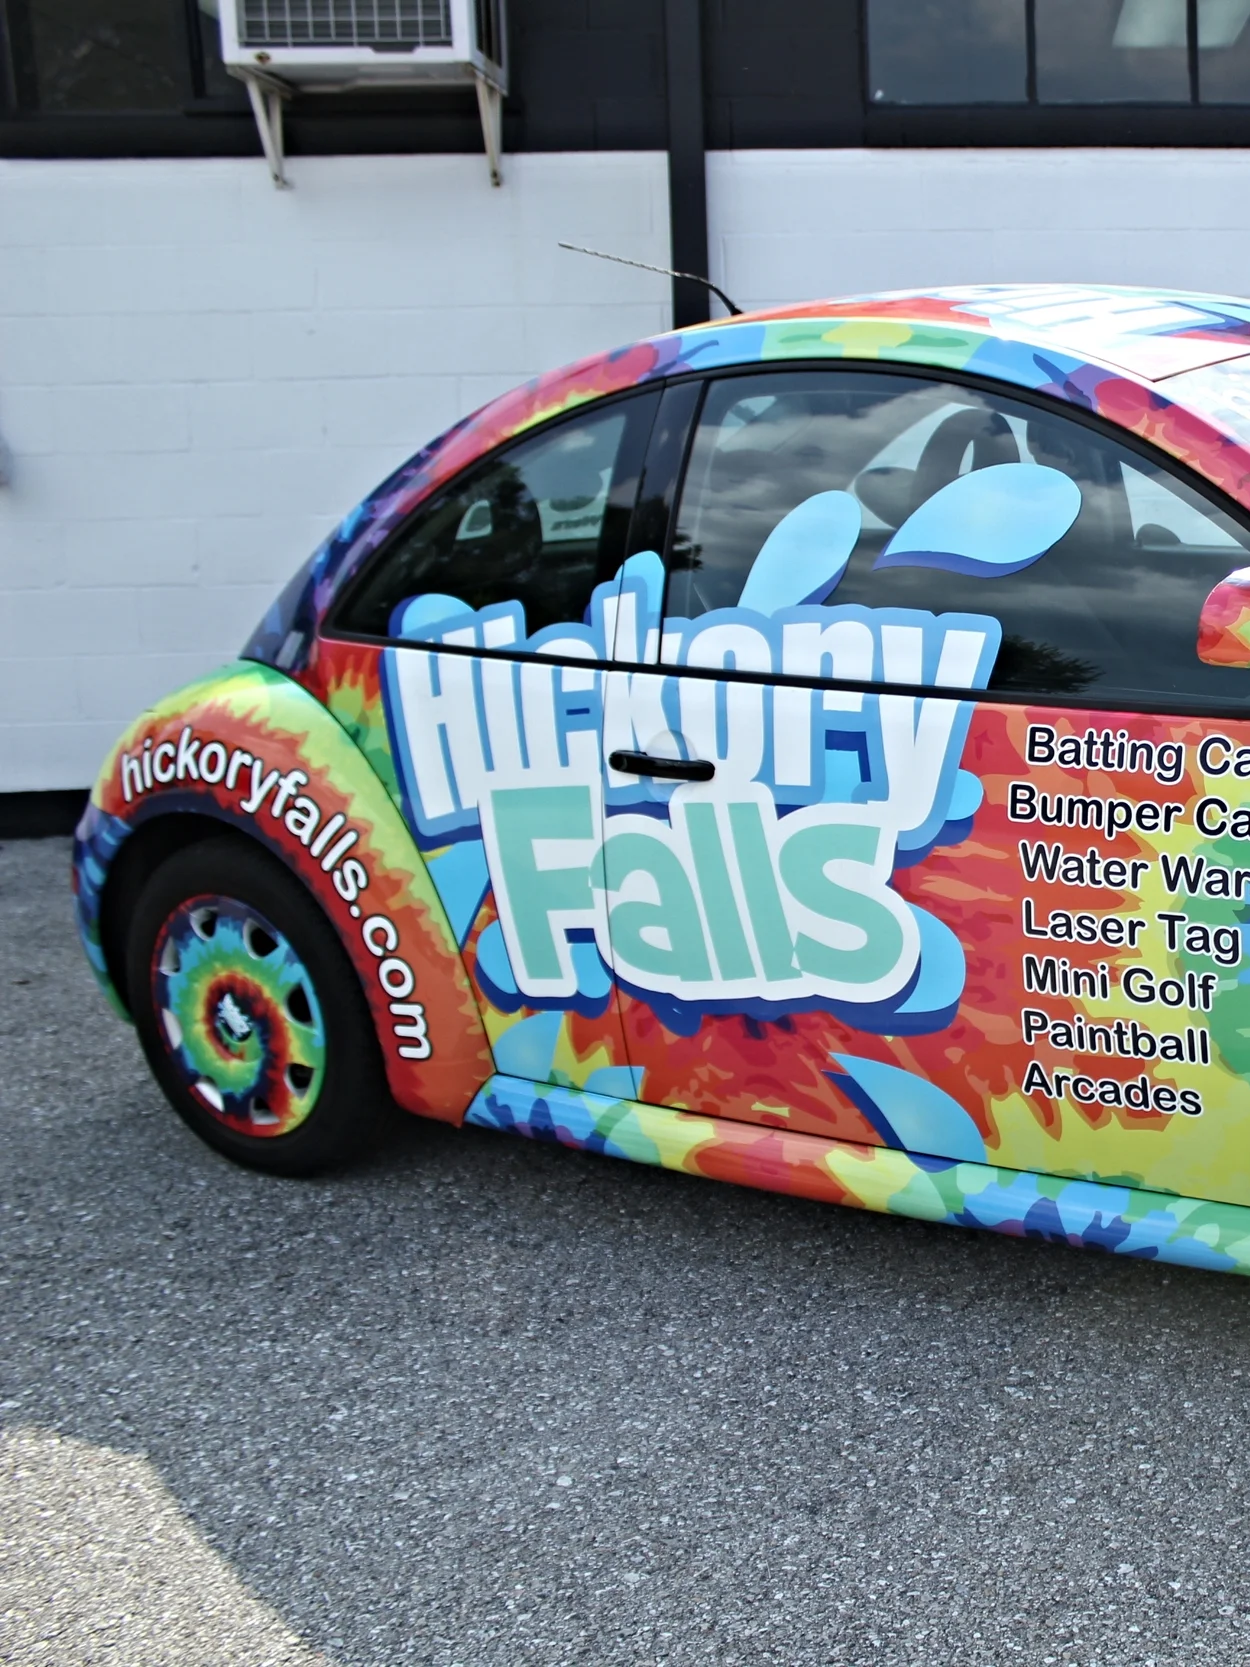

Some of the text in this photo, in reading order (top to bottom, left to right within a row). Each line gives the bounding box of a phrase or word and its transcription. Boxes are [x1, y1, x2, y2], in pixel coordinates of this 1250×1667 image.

[396, 592, 987, 831] Hickory
[1028, 726, 1183, 782] Batting
[1009, 784, 1182, 837] Bumper
[480, 783, 919, 998] Falls
[1019, 841, 1149, 889] Water
[120, 726, 432, 1060] hickoryfalls.com
[1023, 899, 1240, 964] Laser Tag
[1024, 956, 1217, 1011] Mini Golf
[1022, 1010, 1210, 1065] Paintball
[1022, 1063, 1203, 1116] Arcades
